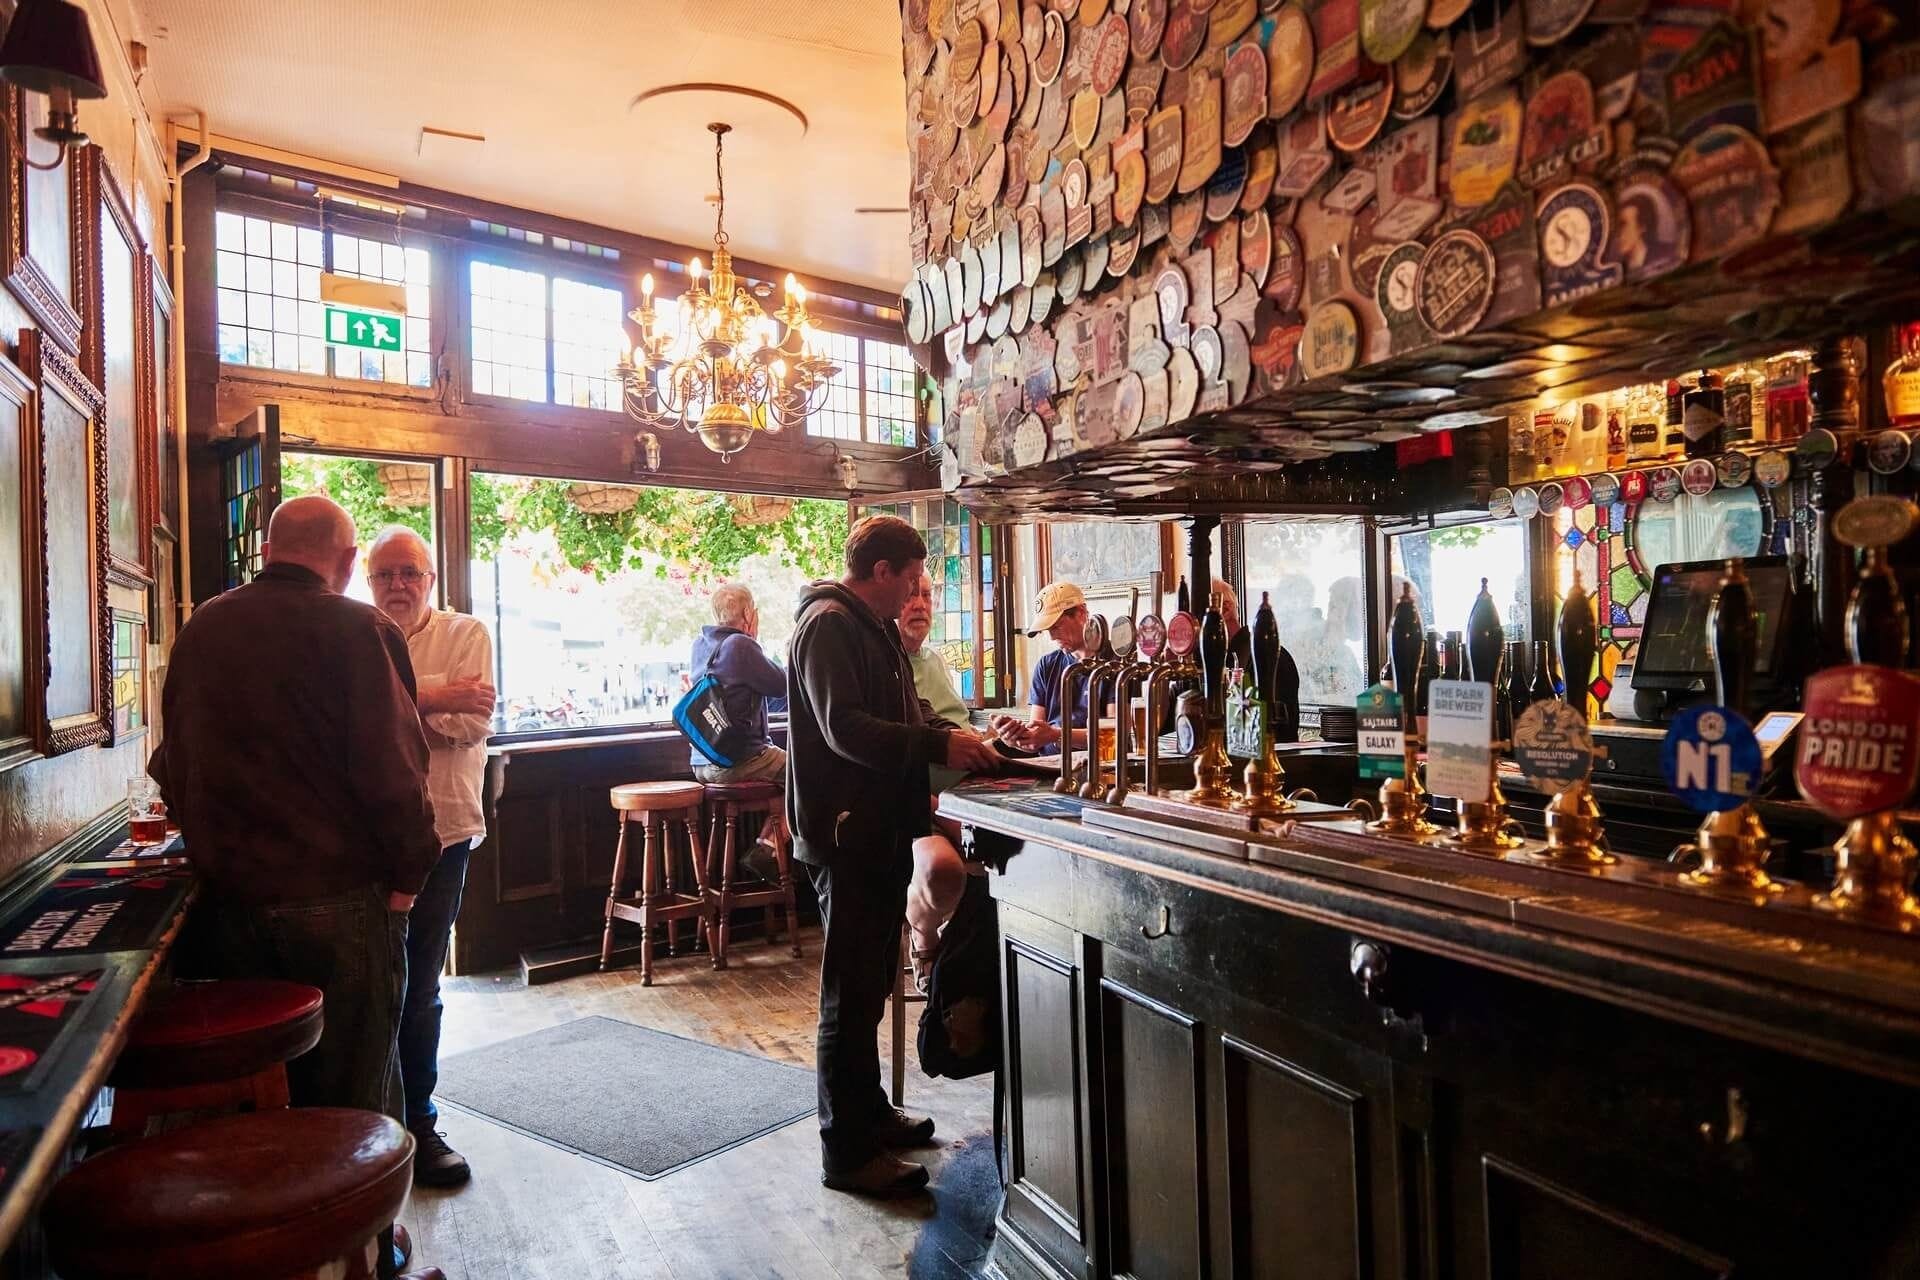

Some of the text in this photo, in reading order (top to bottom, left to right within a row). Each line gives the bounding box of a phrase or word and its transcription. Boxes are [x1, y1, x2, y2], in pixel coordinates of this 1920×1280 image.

[1435, 687, 1485, 700] THE PARK
[1434, 700, 1485, 713] BREWERY
[1362, 718, 1398, 728] SALTAIRE
[1806, 718, 1908, 740] LONDON
[1365, 736, 1397, 749] GALAXY
[1526, 750, 1579, 761] RESOLUTION
[1802, 735, 1905, 774] PRIDE
